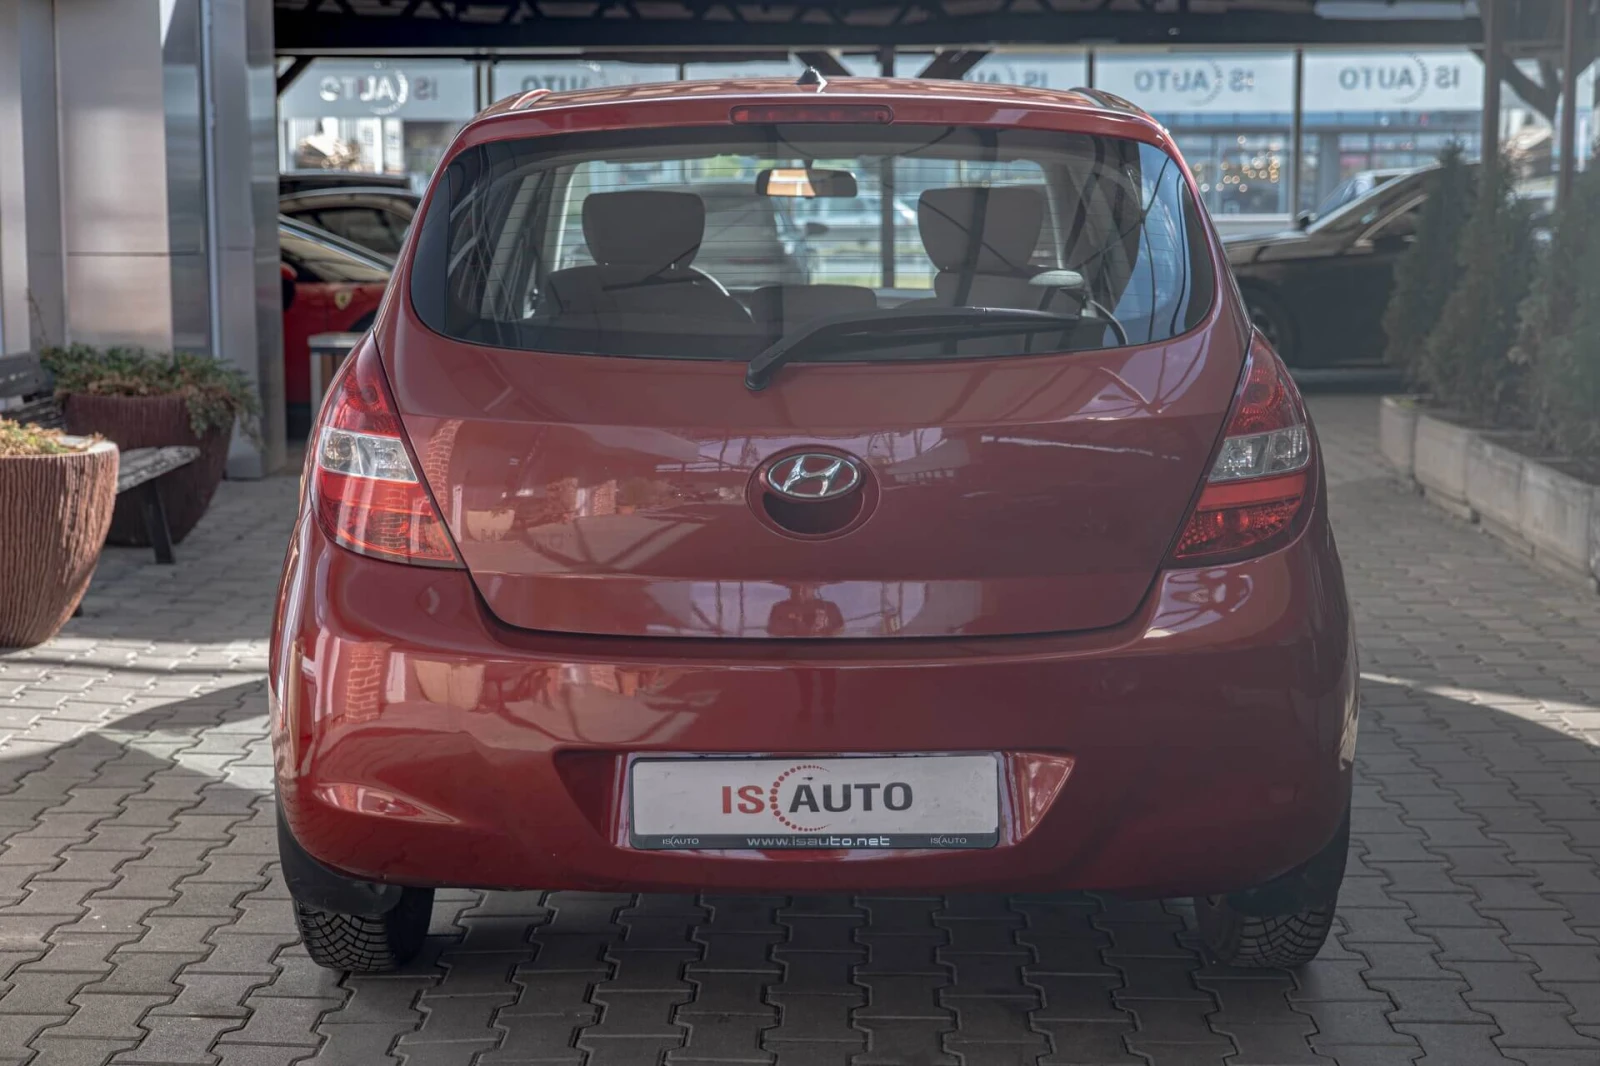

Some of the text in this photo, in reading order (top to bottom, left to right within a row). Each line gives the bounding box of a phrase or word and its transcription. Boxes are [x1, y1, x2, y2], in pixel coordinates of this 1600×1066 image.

[721, 781, 914, 815] IS AUTO
[746, 835, 891, 847] www.isauto.net
